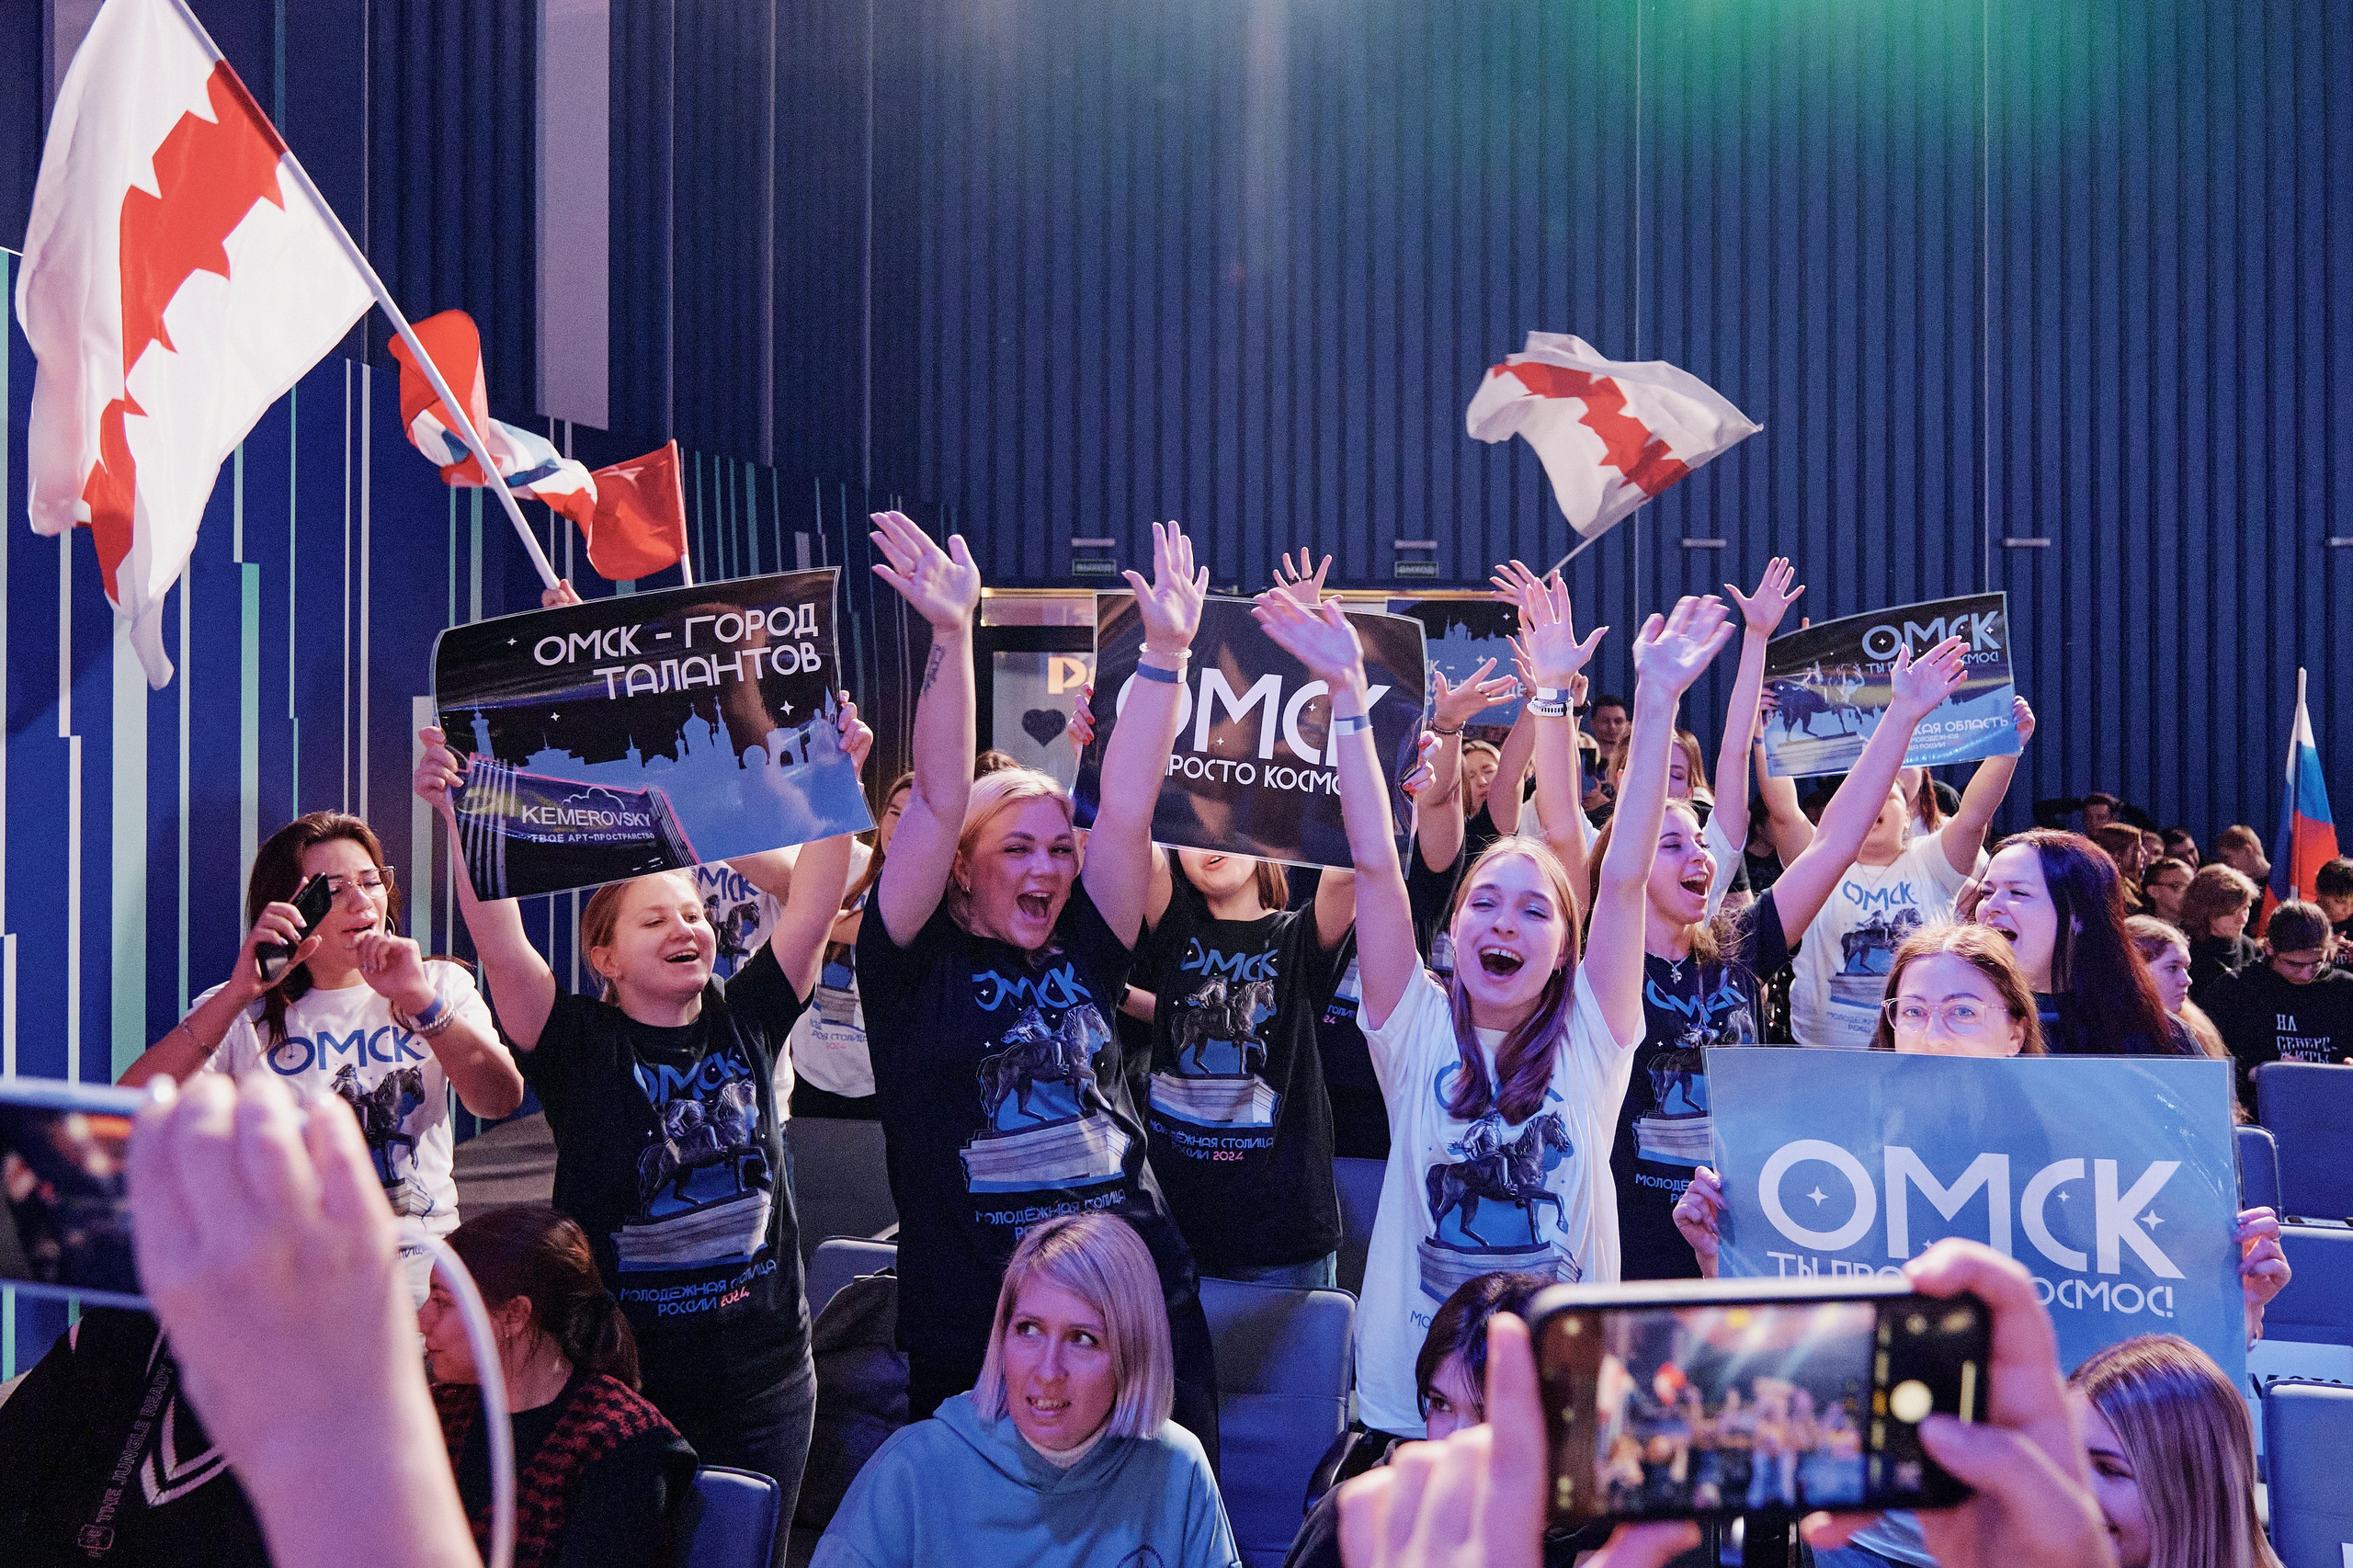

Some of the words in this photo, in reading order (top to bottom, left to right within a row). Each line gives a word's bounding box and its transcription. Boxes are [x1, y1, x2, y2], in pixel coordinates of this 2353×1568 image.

[534, 624, 642, 666] ОМСК
[685, 603, 819, 648] ГОРОД
[593, 642, 822, 699] ТАЛАНТОВ
[1866, 663, 1885, 674] ТЫ
[1913, 722, 1941, 735] КАЯ
[1945, 716, 2008, 733] ОБЛАСТЬ
[1165, 754, 1256, 785] РОСТО
[521, 805, 651, 827] KEMEROVSKY
[568, 832, 655, 843] АРТ-ПРОСТРАНСТВО
[695, 867, 760, 902] МСК
[1842, 880, 1918, 911] ОМСК
[267, 1025, 427, 1076] ОМСК
[1212, 1151, 1245, 1161] 2024
[1221, 1137, 1274, 1149] СТОЛИЦА
[1635, 1173, 1690, 1192] МОЛОДЁ
[1758, 1139, 2187, 1280] ОМСК
[1767, 1251, 1819, 1280] ТЫ
[2029, 1277, 2174, 1318] ОСМОС!
[112, 1420, 152, 1486] JUNGLE
